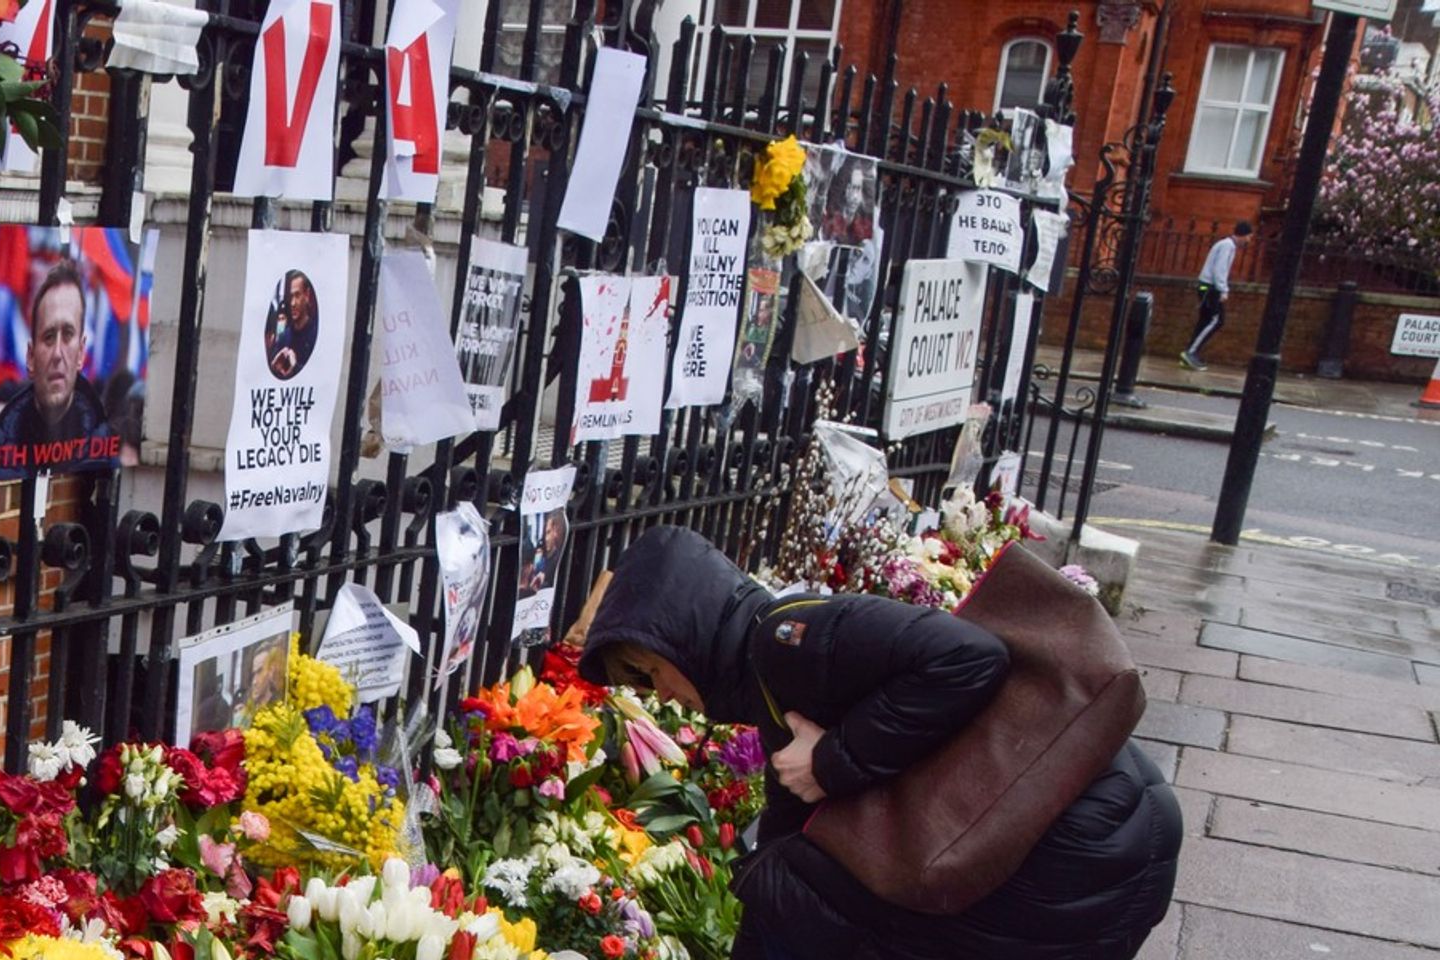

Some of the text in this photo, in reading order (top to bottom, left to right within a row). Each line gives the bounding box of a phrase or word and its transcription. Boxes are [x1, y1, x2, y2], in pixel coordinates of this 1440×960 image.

[976, 194, 1002, 209] ЭТО
[712, 218, 739, 237] CAN
[958, 215, 977, 229] НЕ
[719, 274, 743, 290] THE
[913, 279, 963, 323] PALACE
[1401, 332, 1438, 344] COURT
[907, 330, 974, 378] COURT W2
[251, 386, 315, 408] WE WILL
[251, 405, 312, 429] NOT LET
[260, 425, 302, 448] YOUR
[32, 437, 87, 466] WON'T
[89, 435, 121, 458] DIE
[237, 443, 322, 470] LEGACY DIE
[230, 480, 326, 511] #FreeNavalny
